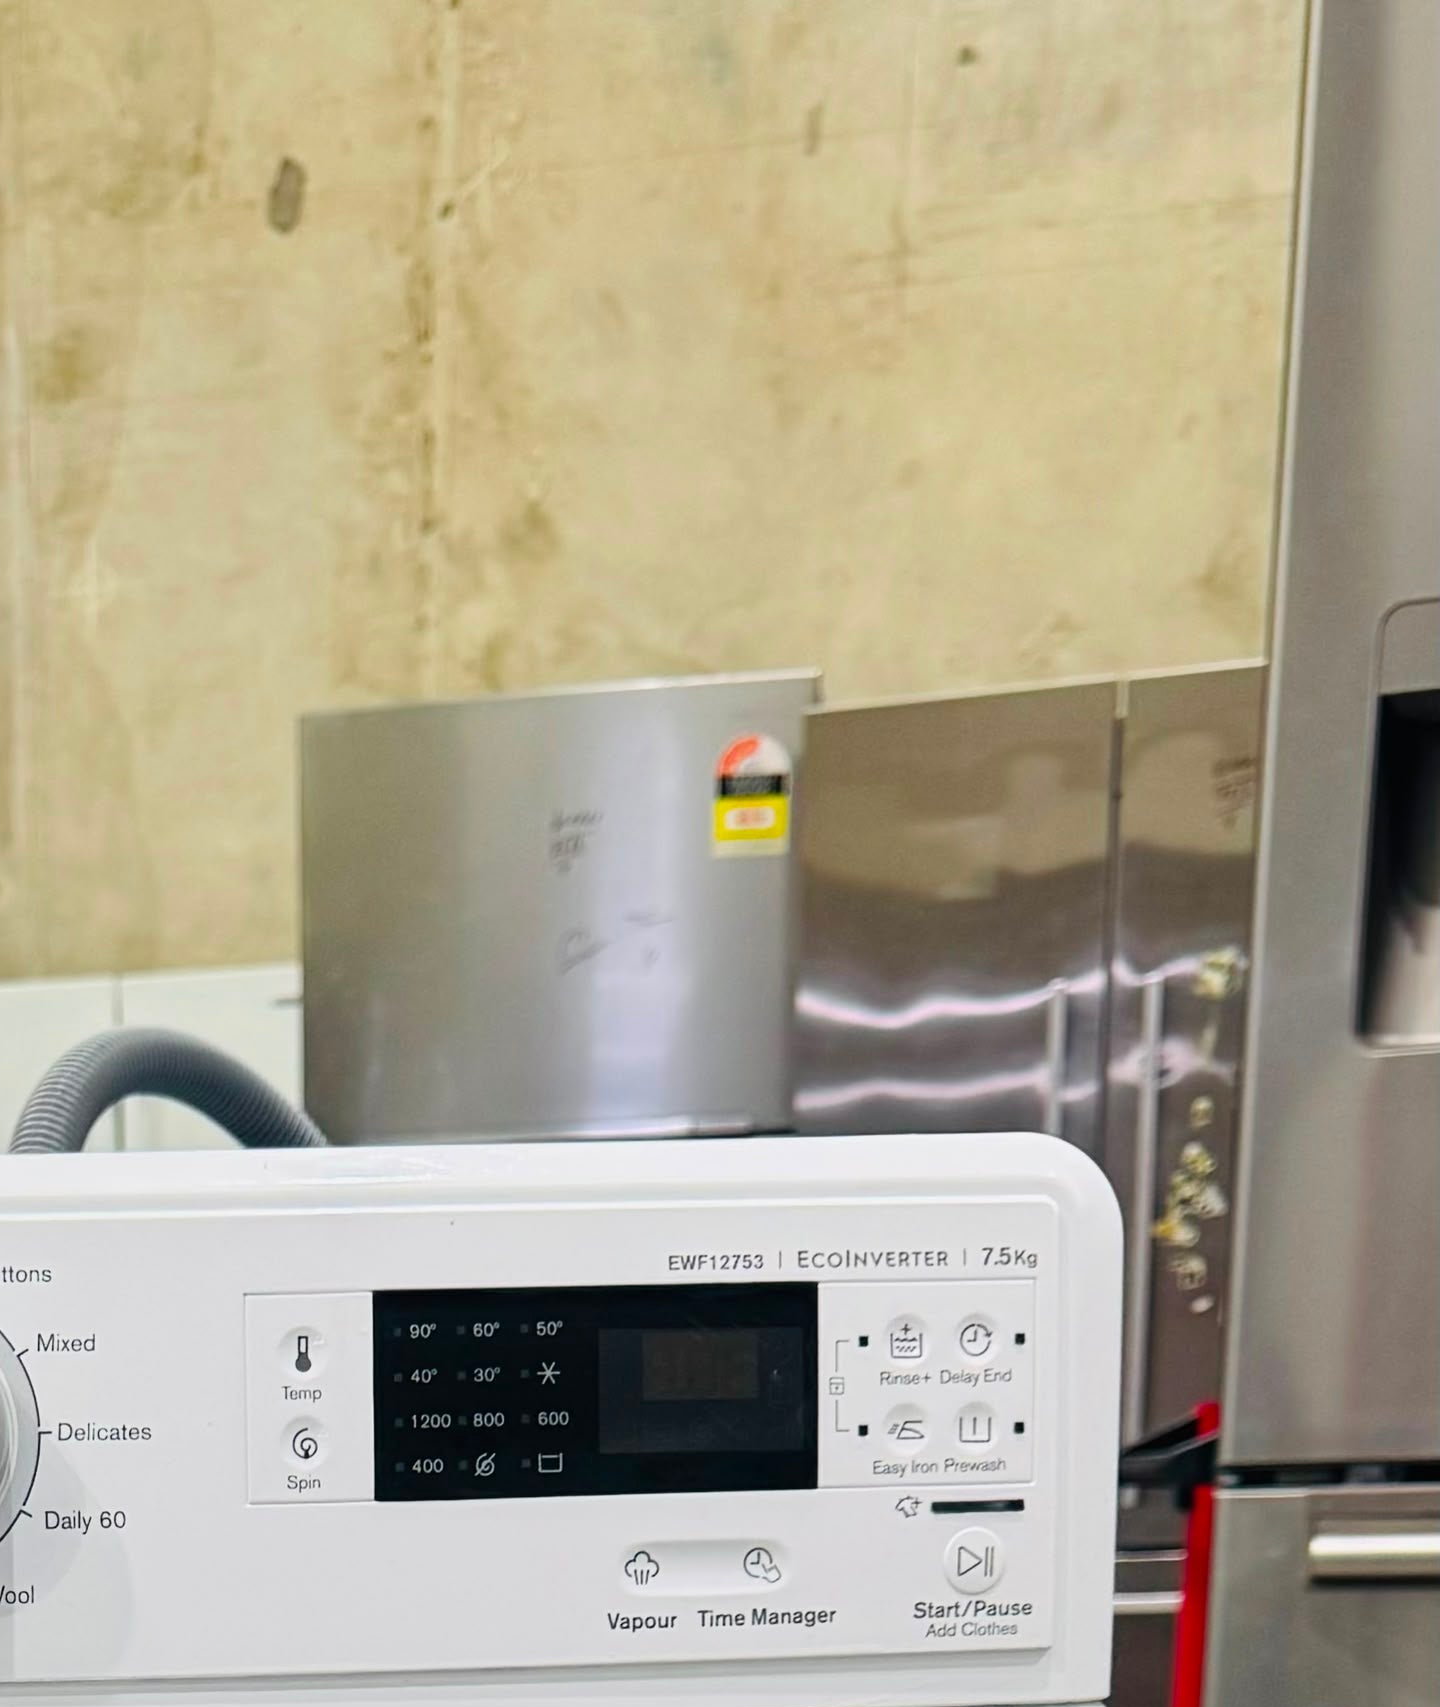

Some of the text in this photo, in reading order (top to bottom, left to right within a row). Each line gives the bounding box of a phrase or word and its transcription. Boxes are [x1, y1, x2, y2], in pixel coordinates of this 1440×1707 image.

[667, 1253, 764, 1271] EWF12753
[37, 1333, 96, 1353] Mixed
[939, 1369, 980, 1388] Delay
[983, 1369, 1012, 1384] End
[282, 1386, 322, 1403] Temp
[411, 1411, 569, 1429] 1200 800 600
[57, 1423, 152, 1443] Delicates
[412, 1458, 444, 1474] 400
[872, 1458, 1006, 1478] Easy Iron Prewash
[287, 1475, 321, 1493] Spin
[44, 1511, 127, 1534] Daily 60
[913, 1600, 1033, 1619] Start/Pause
[607, 1607, 837, 1634] Vapour Time Manager
[926, 1621, 1018, 1638] Add Clothes
